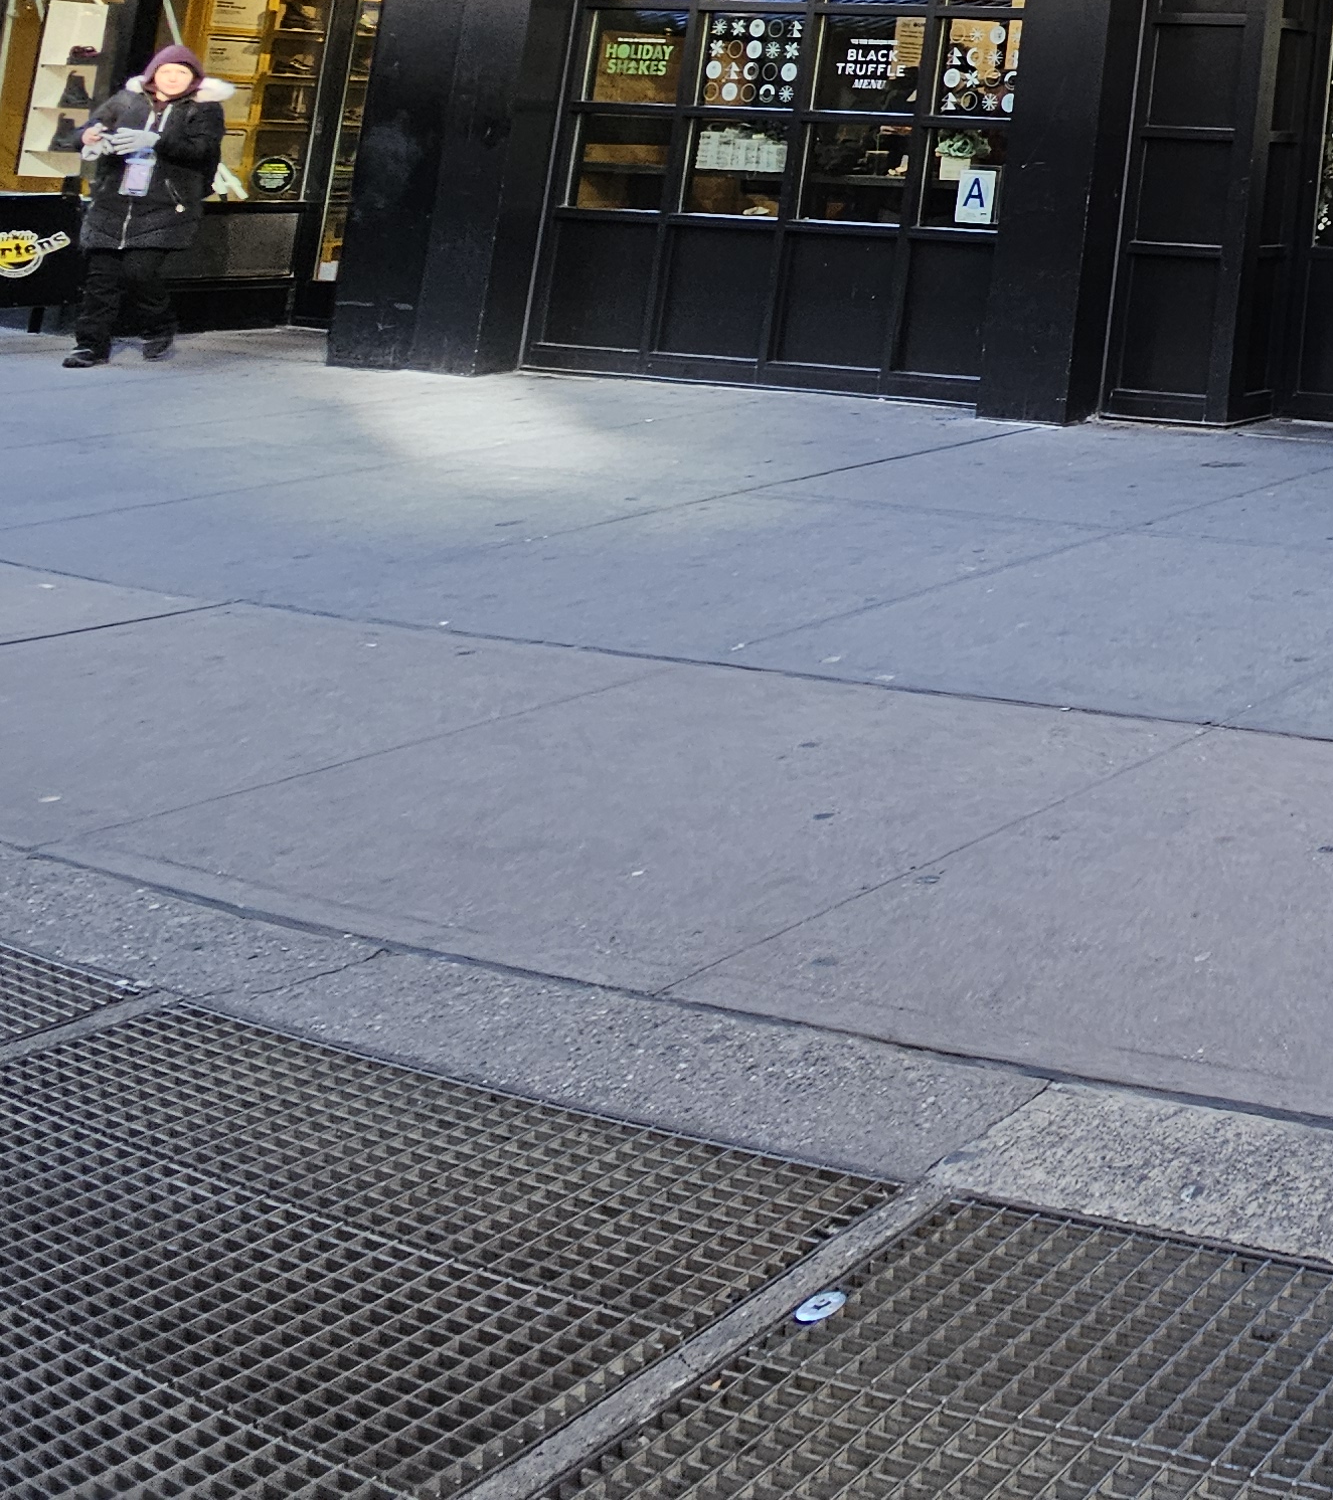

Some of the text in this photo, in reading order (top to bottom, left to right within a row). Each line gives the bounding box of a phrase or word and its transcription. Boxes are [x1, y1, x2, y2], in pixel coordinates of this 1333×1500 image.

[605, 43, 675, 60] HOLIDAY
[847, 49, 899, 62] BLACK
[606, 58, 667, 76] SHAKES
[836, 62, 906, 77] TRUFFLE
[852, 78, 887, 89] MENU
[962, 177, 985, 208] A
